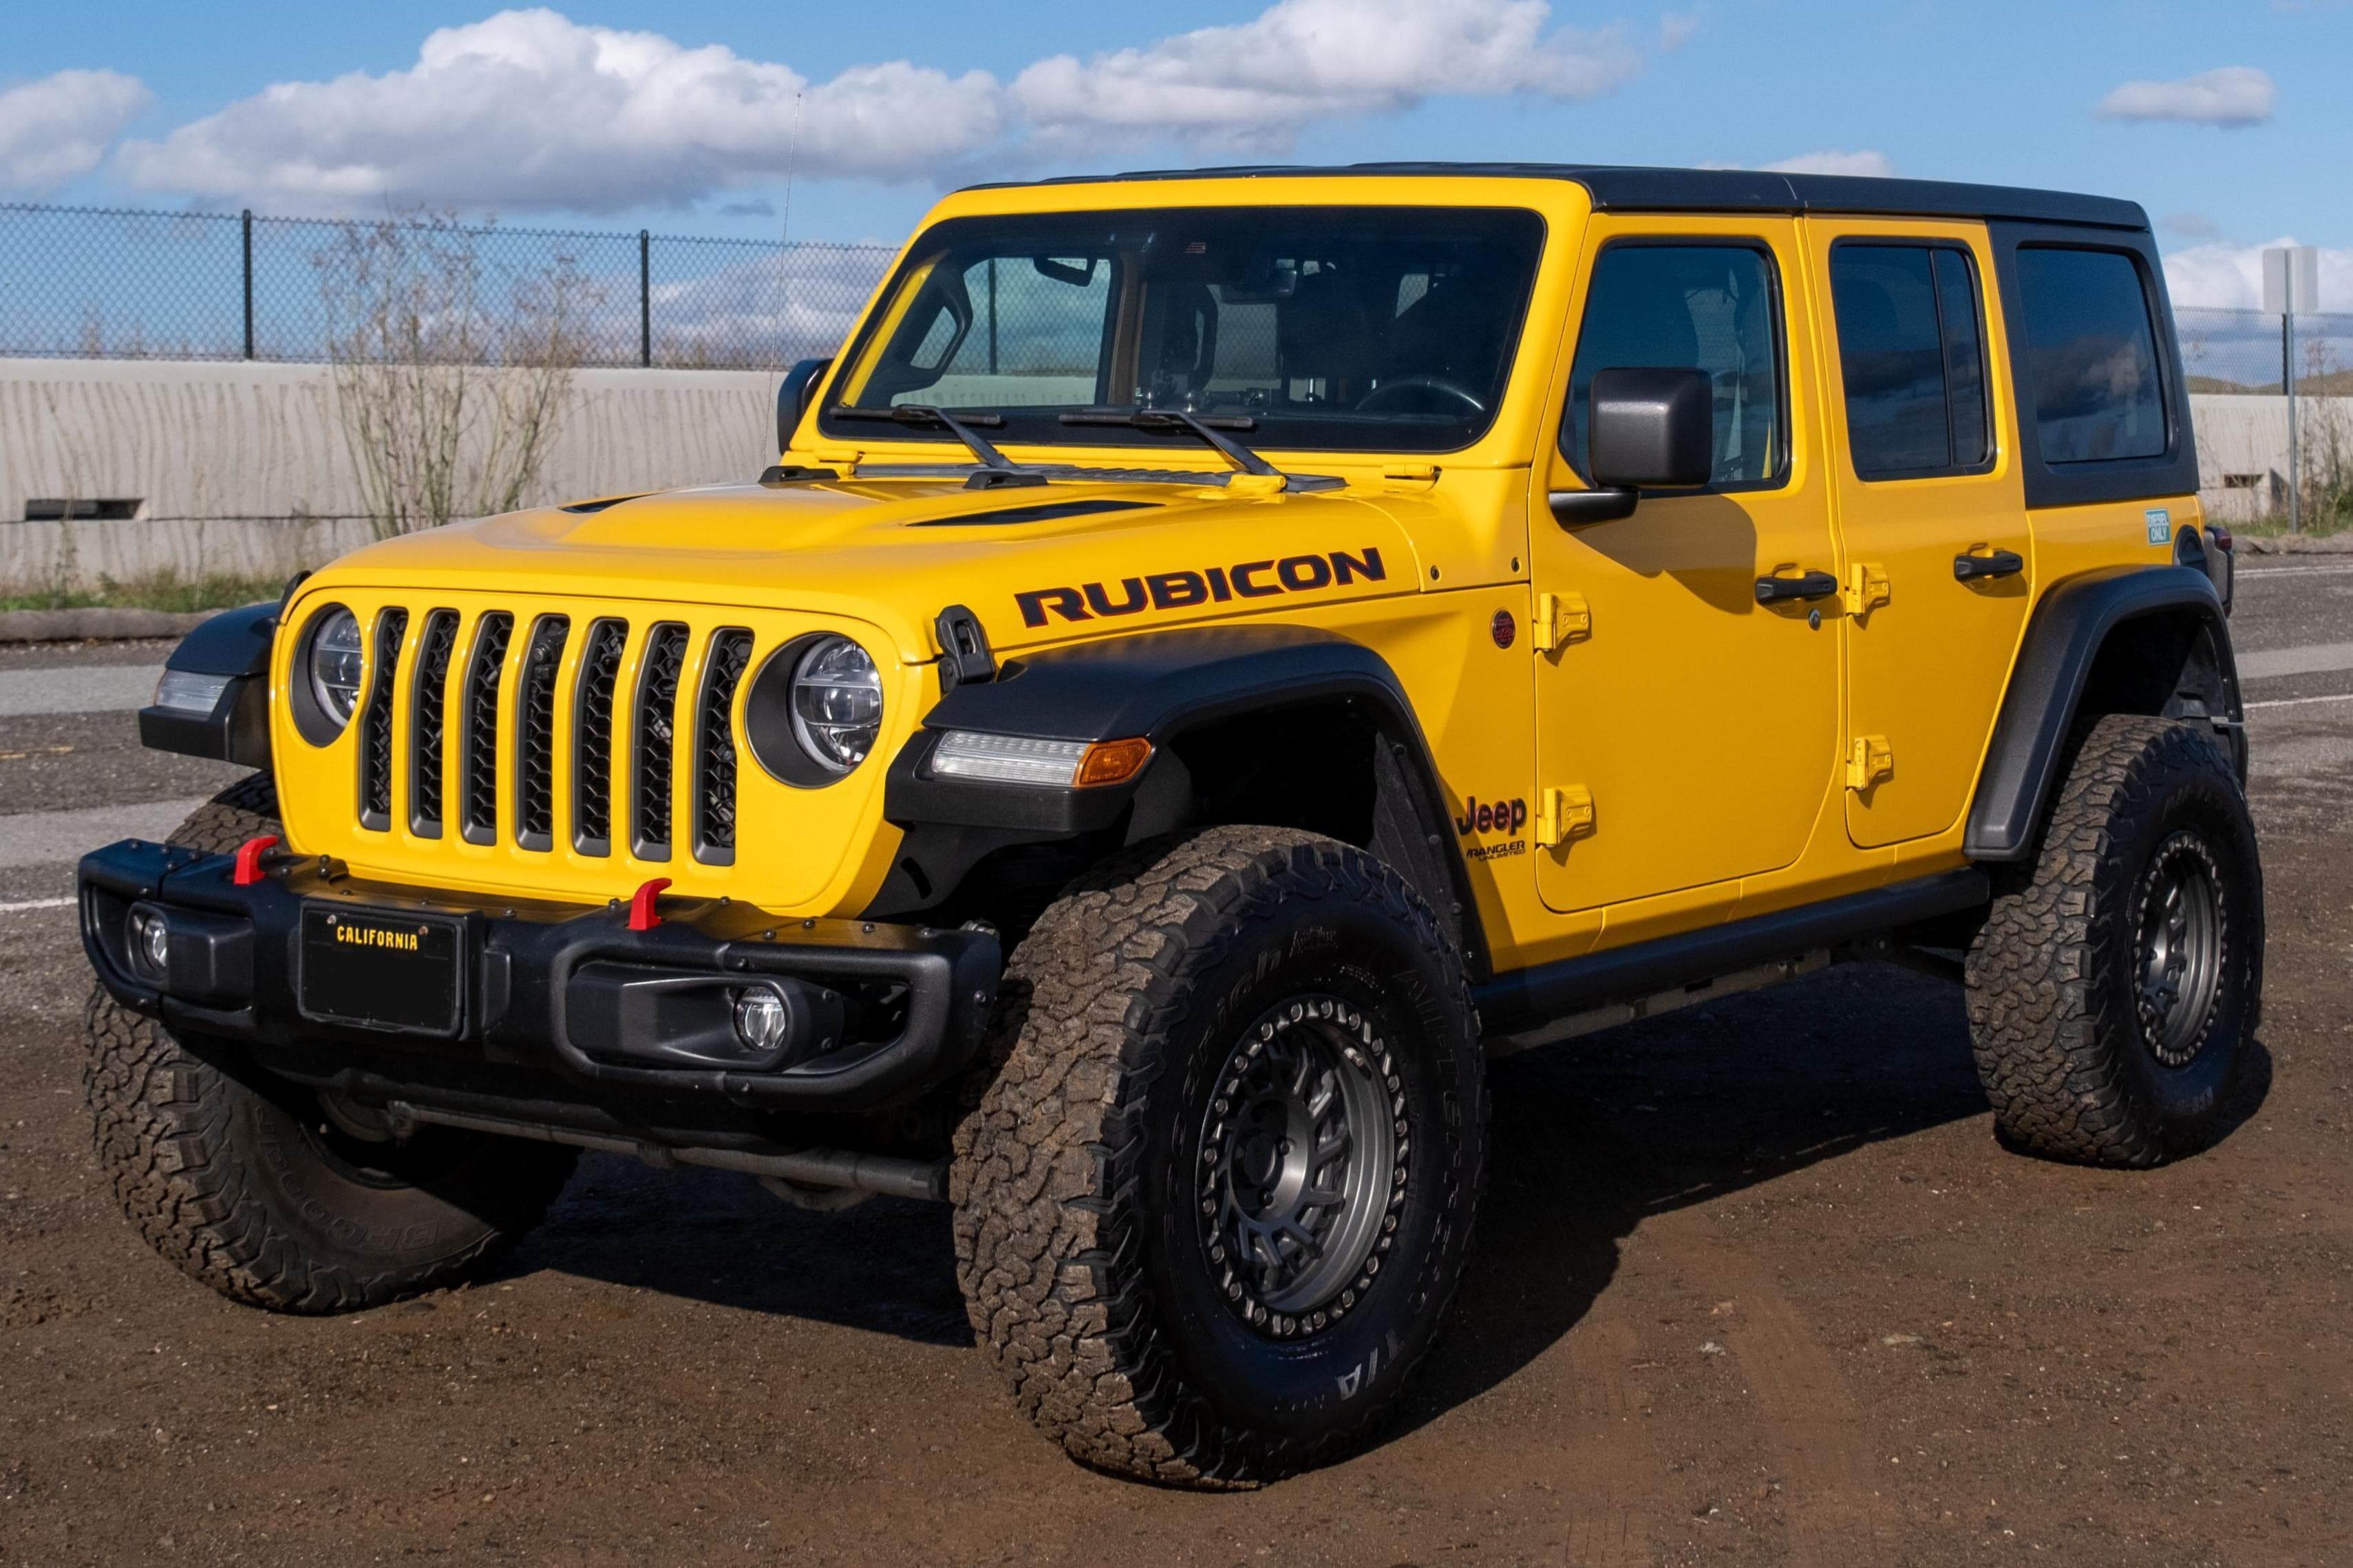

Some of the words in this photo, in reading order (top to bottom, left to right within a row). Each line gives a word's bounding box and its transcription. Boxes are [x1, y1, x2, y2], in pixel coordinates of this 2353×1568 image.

[2150, 526, 2167, 541] ONLY
[1014, 547, 1387, 628] RUBICON
[1455, 795, 1527, 836] Jeep
[1478, 848, 1525, 862] UNLIMITED
[337, 925, 418, 950] CALIFORNIA
